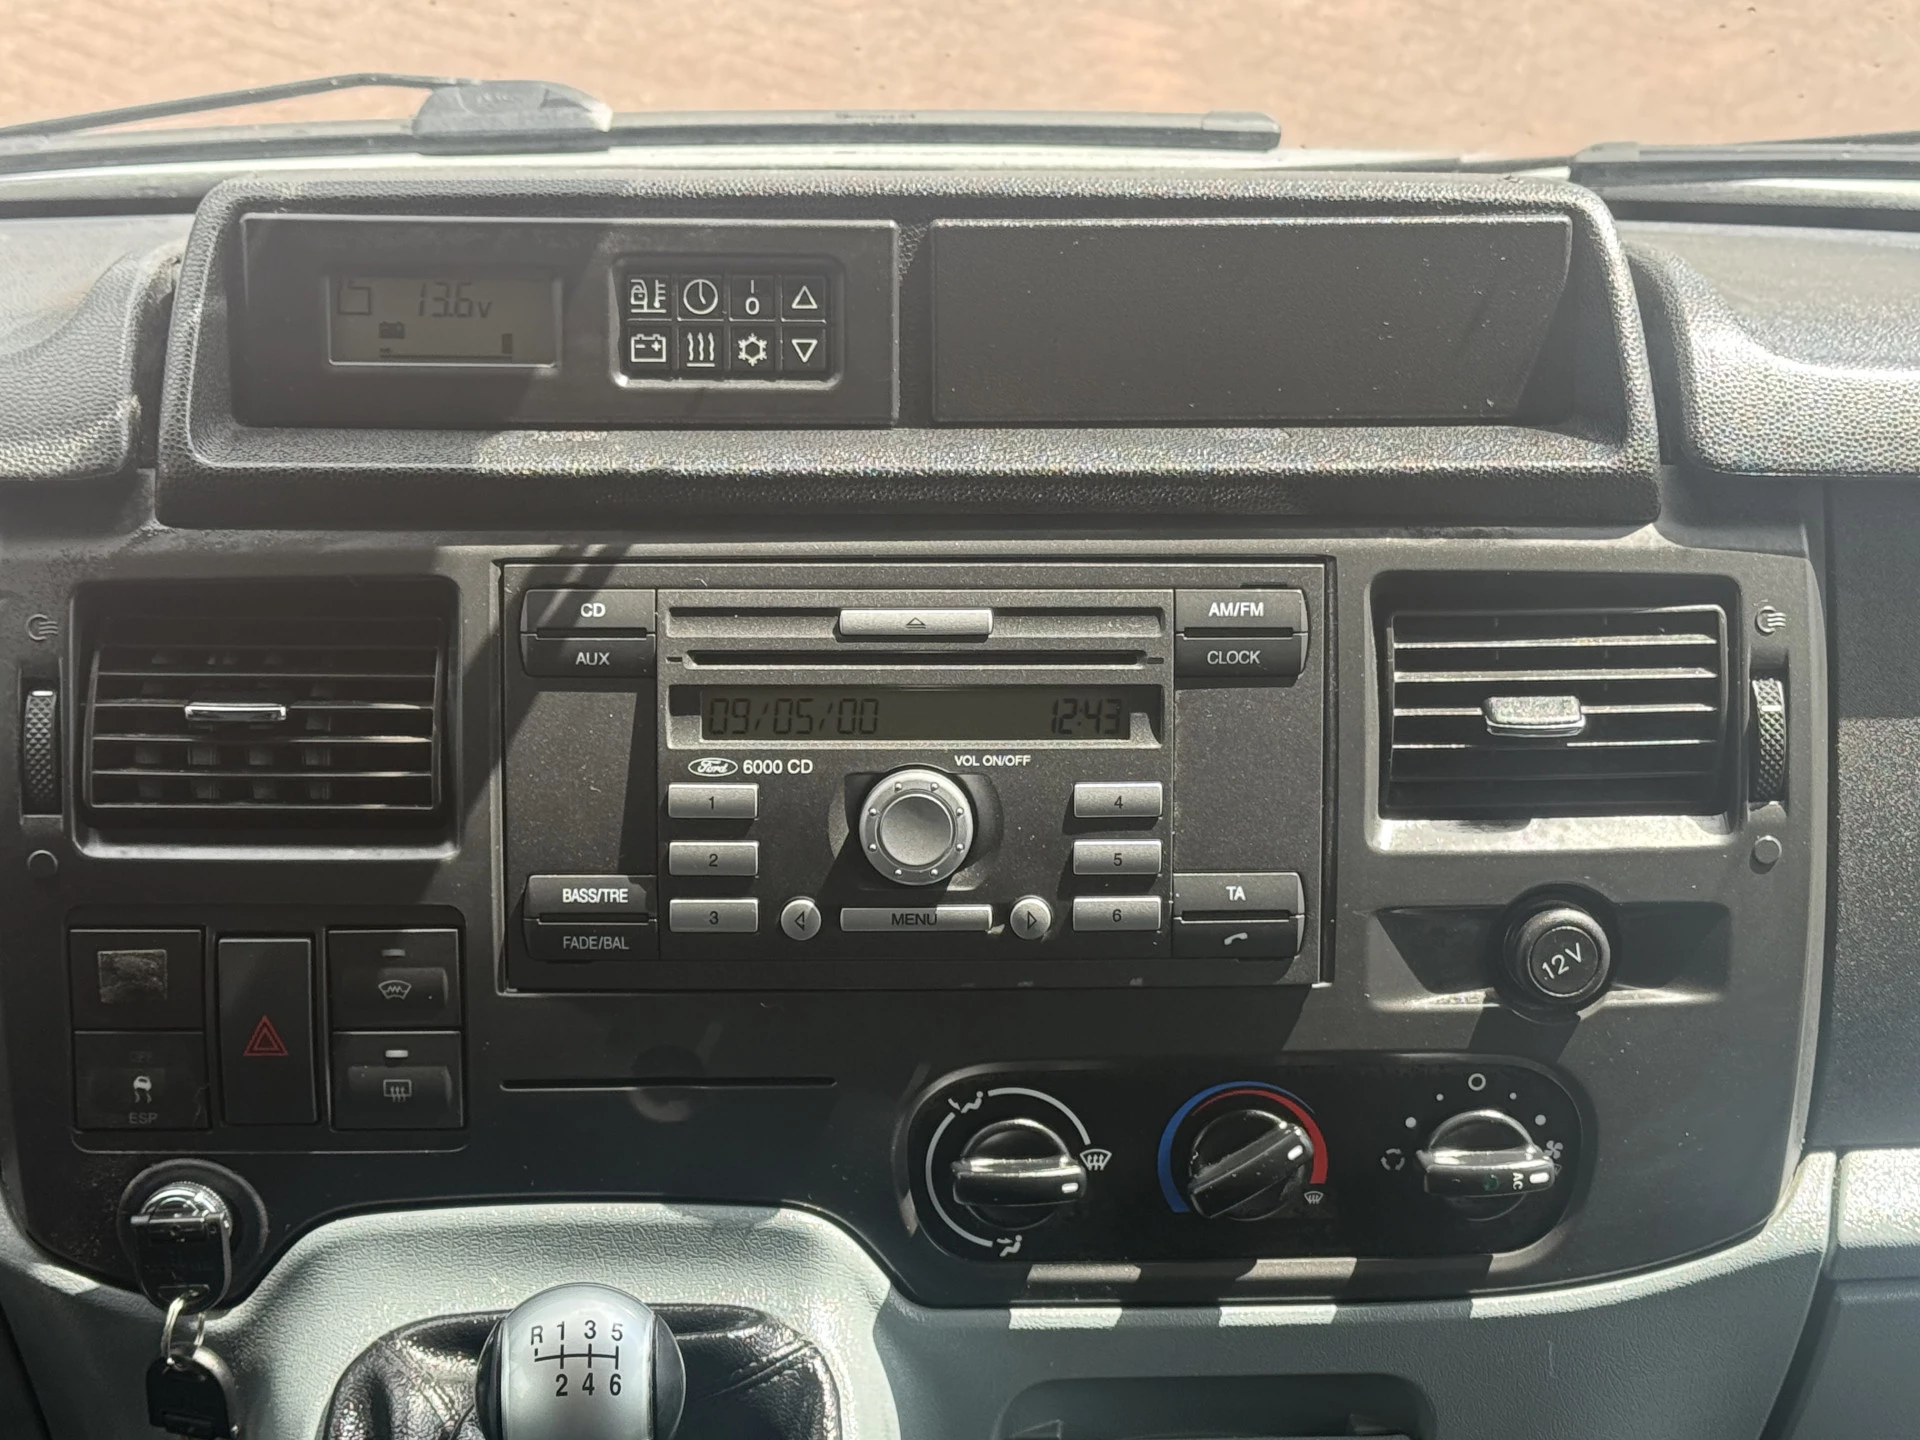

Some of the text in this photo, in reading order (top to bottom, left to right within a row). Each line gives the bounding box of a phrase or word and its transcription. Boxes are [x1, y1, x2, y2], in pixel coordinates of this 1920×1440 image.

[580, 603, 606, 618] CD
[1208, 602, 1264, 618] AM/FM
[575, 651, 610, 666] AUX
[1206, 650, 1261, 665] CLOCK
[707, 697, 880, 735] 09/05/00
[1050, 697, 1122, 735] 12:43
[694, 759, 813, 775] Ford 6000 CD
[954, 754, 1031, 767] VOL ON/OFF
[708, 796, 716, 810] 1
[1113, 795, 1124, 809] 4
[708, 853, 719, 867] 2
[1112, 852, 1123, 867] 5
[562, 888, 629, 904] BASS/TRE
[1225, 885, 1246, 901] TA
[709, 911, 719, 925] 3
[891, 912, 938, 926] MENU
[1111, 908, 1122, 923] 6
[562, 935, 630, 951] FADE/BAL
[1541, 942, 1583, 980] 12V
[128, 1111, 158, 1125] ESP
[1512, 1172, 1524, 1190] AC
[530, 1319, 623, 1345] R 1 3 5
[555, 1372, 622, 1396] 2 4 6
